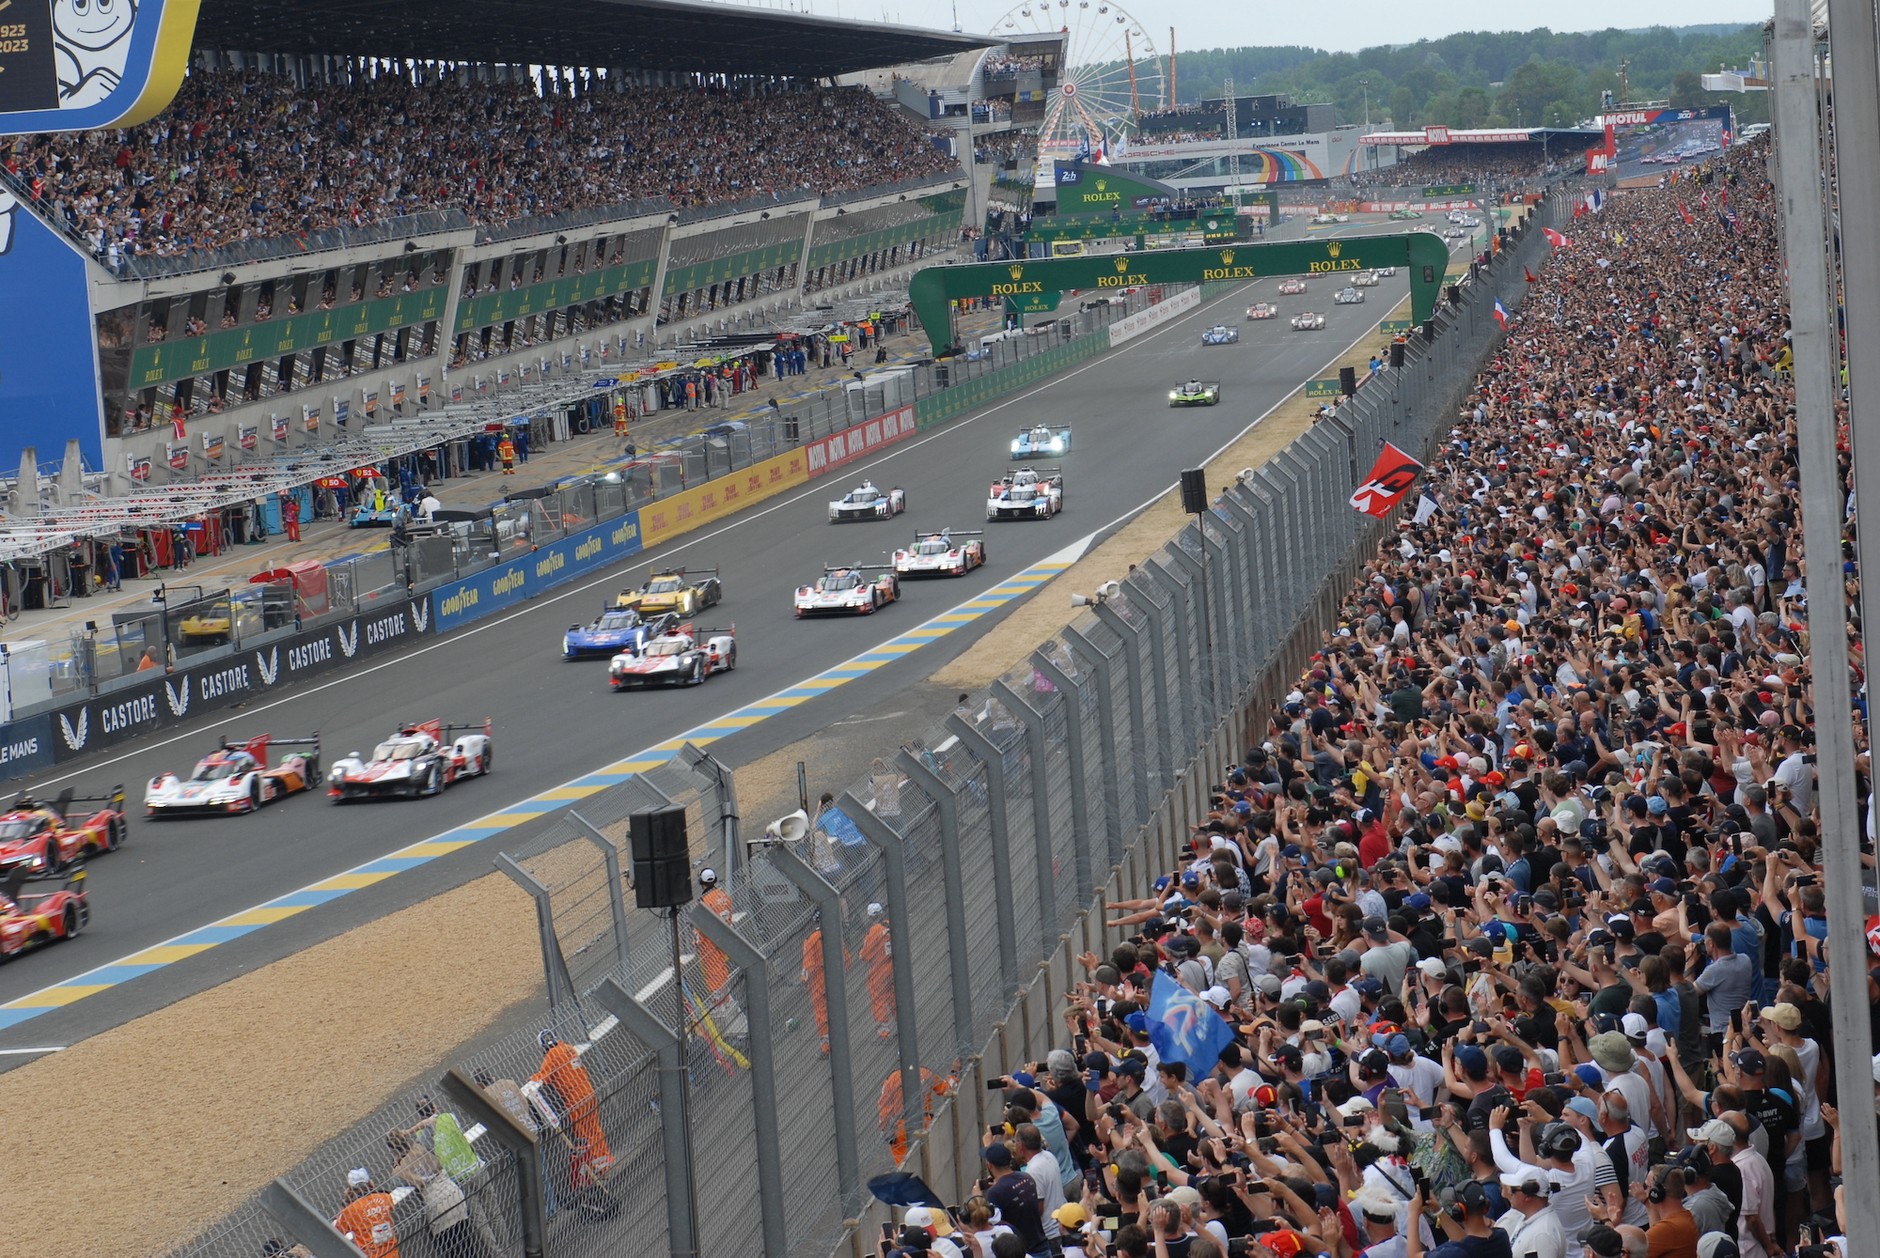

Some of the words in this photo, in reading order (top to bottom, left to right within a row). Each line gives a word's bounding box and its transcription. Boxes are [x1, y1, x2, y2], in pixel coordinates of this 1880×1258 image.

[0, 24, 26, 38] 923
[1606, 113, 1646, 124] MOTUL
[1427, 128, 1448, 142] MOTUL
[1083, 192, 1120, 202] ROLEX
[992, 282, 1042, 295] ROLEX
[1098, 274, 1148, 287] ROLEX
[1204, 266, 1254, 280] ROLEX
[1310, 258, 1361, 272] ROLEX
[808, 442, 826, 472] MOTUL
[828, 435, 846, 462] MOTUL
[866, 422, 882, 448] MOTUL
[882, 414, 898, 440] MOTUL
[900, 408, 914, 433] MOTUL
[442, 586, 478, 616] GOODYEAR
[492, 568, 524, 596] GOODYEAR
[536, 550, 564, 577] GOODYEAR
[576, 535, 602, 560] GOODYEAR
[612, 520, 637, 546] GOODYEAR
[102, 694, 156, 734] CASTORE
[201, 664, 249, 700] CASTORE
[288, 638, 332, 671] CASTORE
[367, 613, 405, 645] CASTORE
[10, 738, 38, 760] MANS
